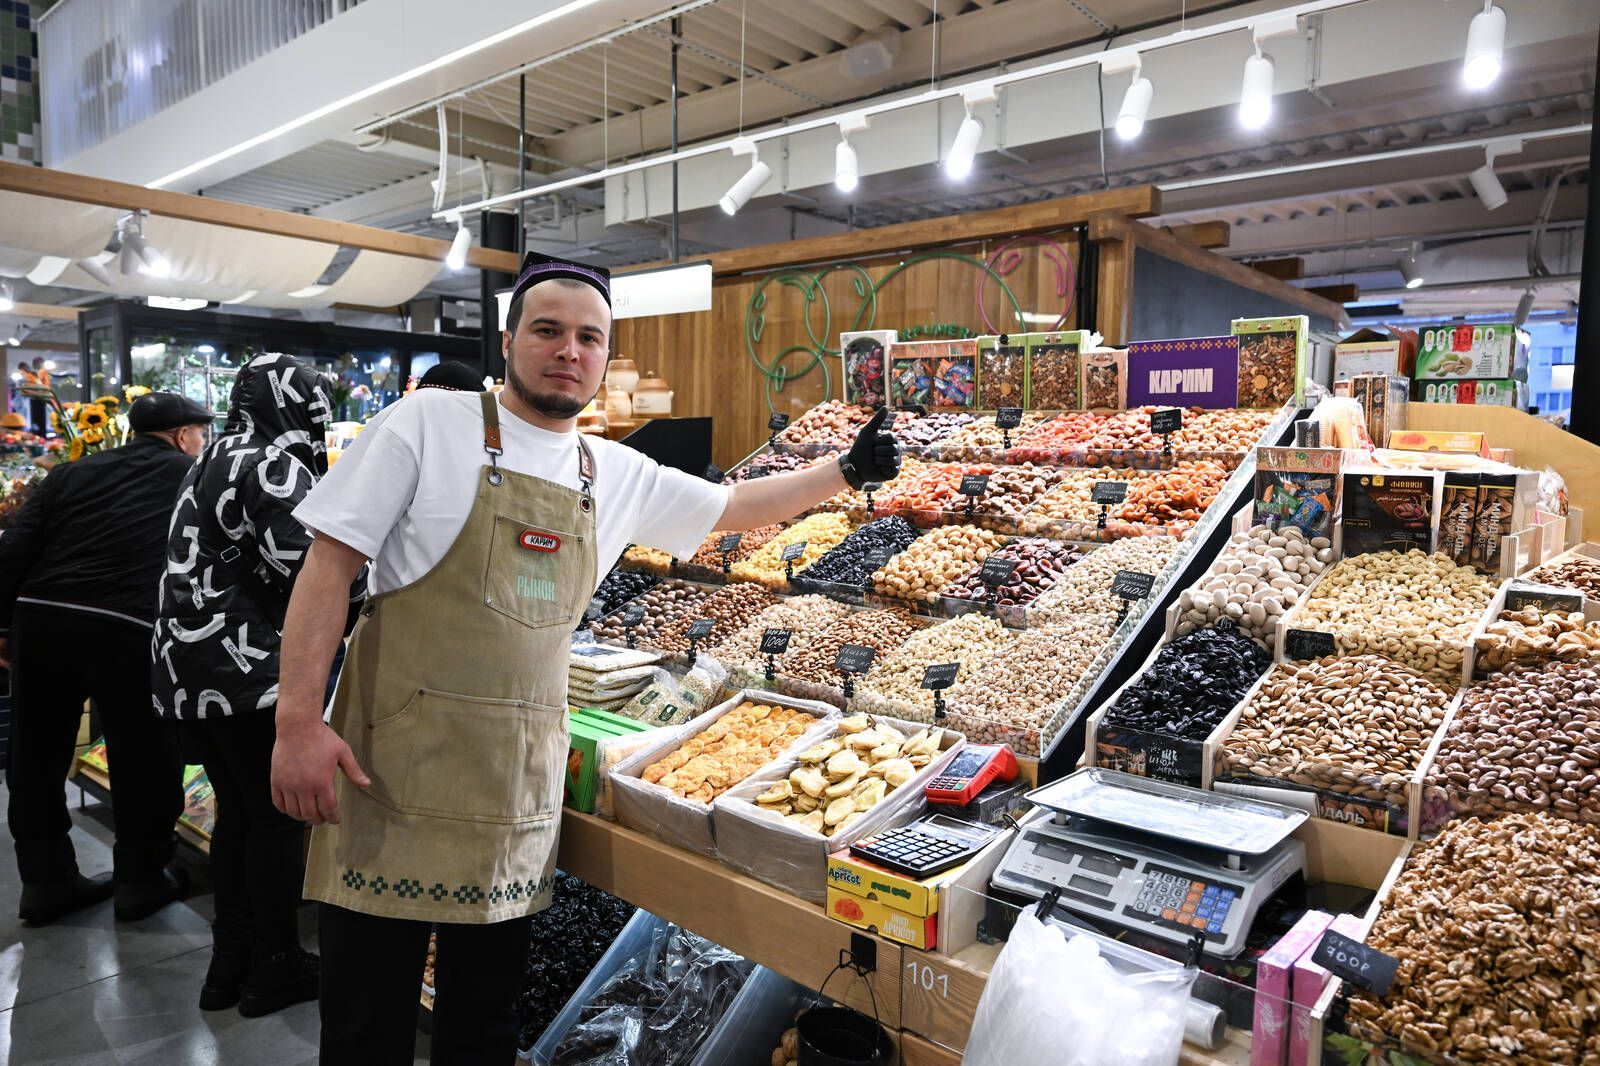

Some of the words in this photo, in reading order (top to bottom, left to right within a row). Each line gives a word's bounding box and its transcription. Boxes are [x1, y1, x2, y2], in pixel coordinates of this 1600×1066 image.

[1149, 368, 1213, 394] КАРИМ
[263, 551, 288, 573] CLIMBER
[517, 576, 555, 602] РЫНОК
[227, 644, 249, 669] CLIMBER
[828, 867, 861, 885] Apricot
[883, 919, 917, 942] APRICOT
[907, 962, 948, 998] 101
